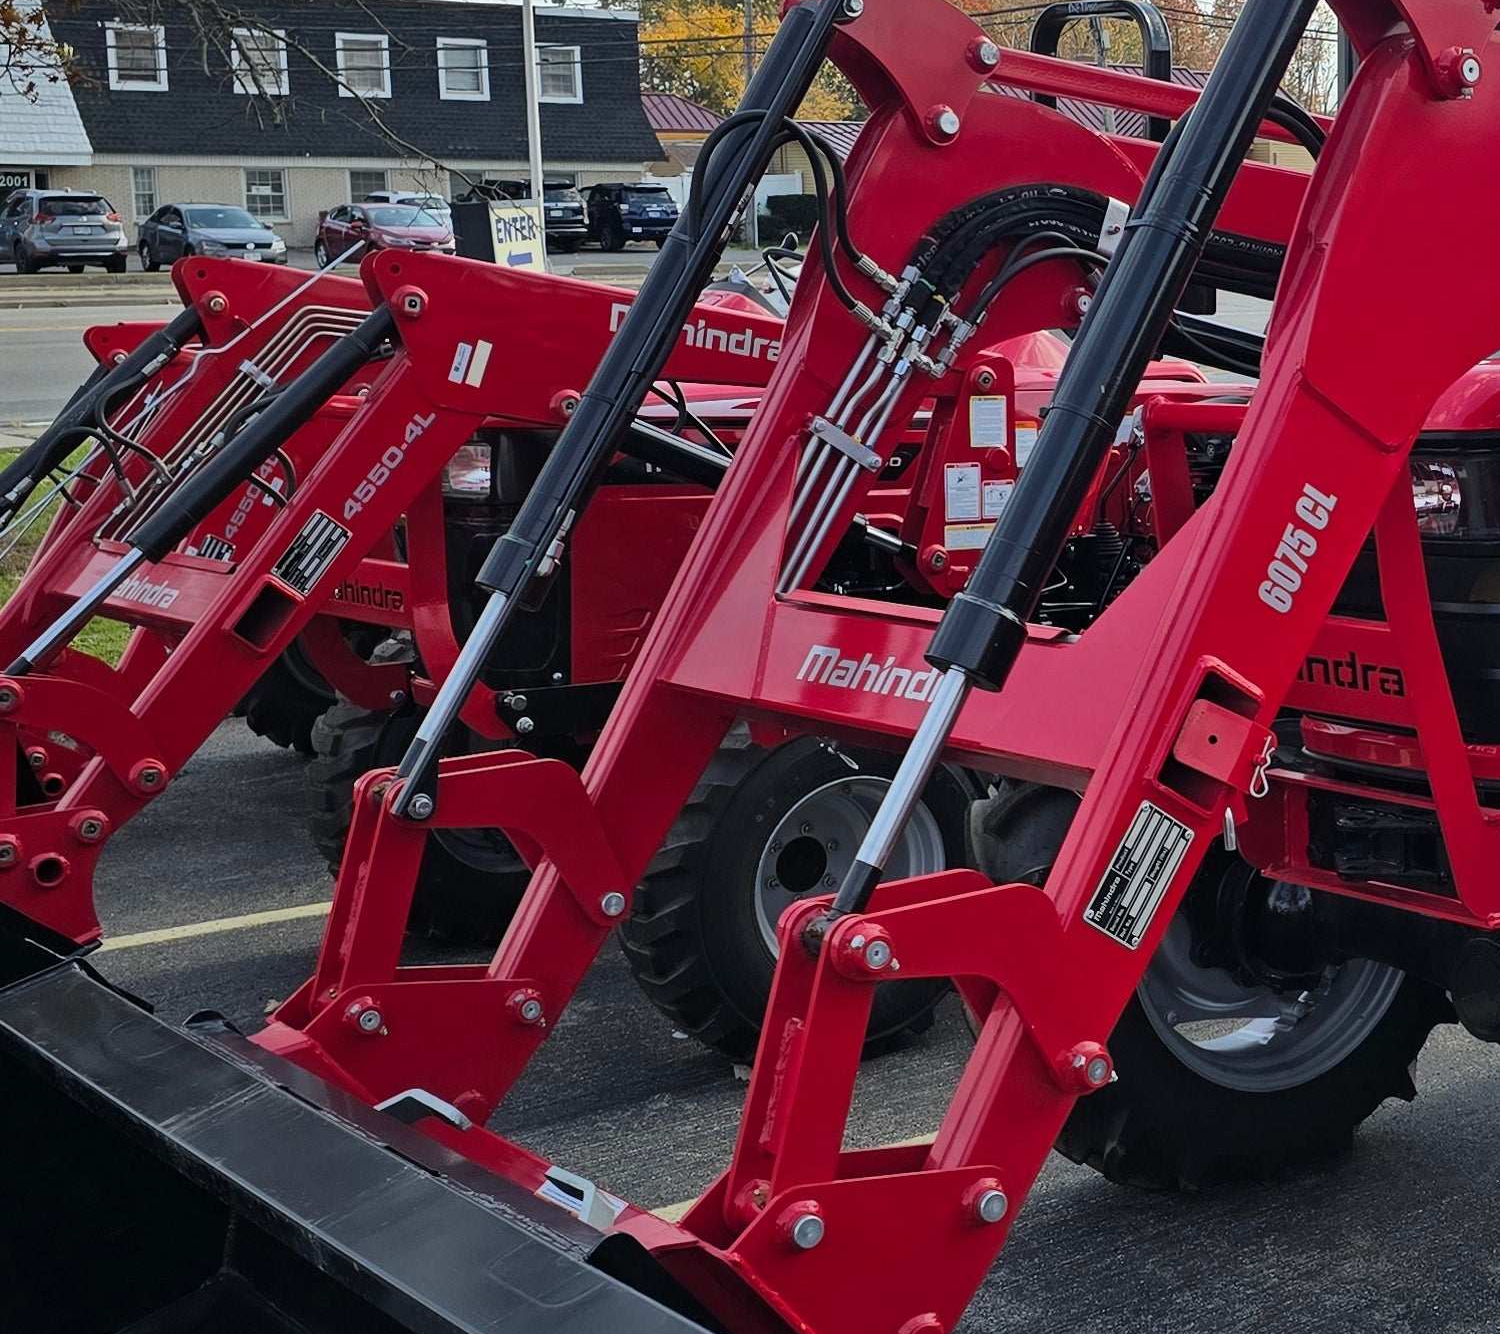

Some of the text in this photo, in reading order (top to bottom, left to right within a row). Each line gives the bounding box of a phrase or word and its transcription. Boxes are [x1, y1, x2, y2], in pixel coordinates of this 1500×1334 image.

[0, 175, 28, 187] 2001
[495, 215, 537, 244] ENTER
[343, 412, 436, 521] 4550-4L
[224, 453, 280, 539] 45504L
[1258, 482, 1338, 613] 6075 CL
[112, 573, 180, 610] ahindra
[337, 578, 405, 612] ahindra
[796, 644, 946, 703] Mahindr
